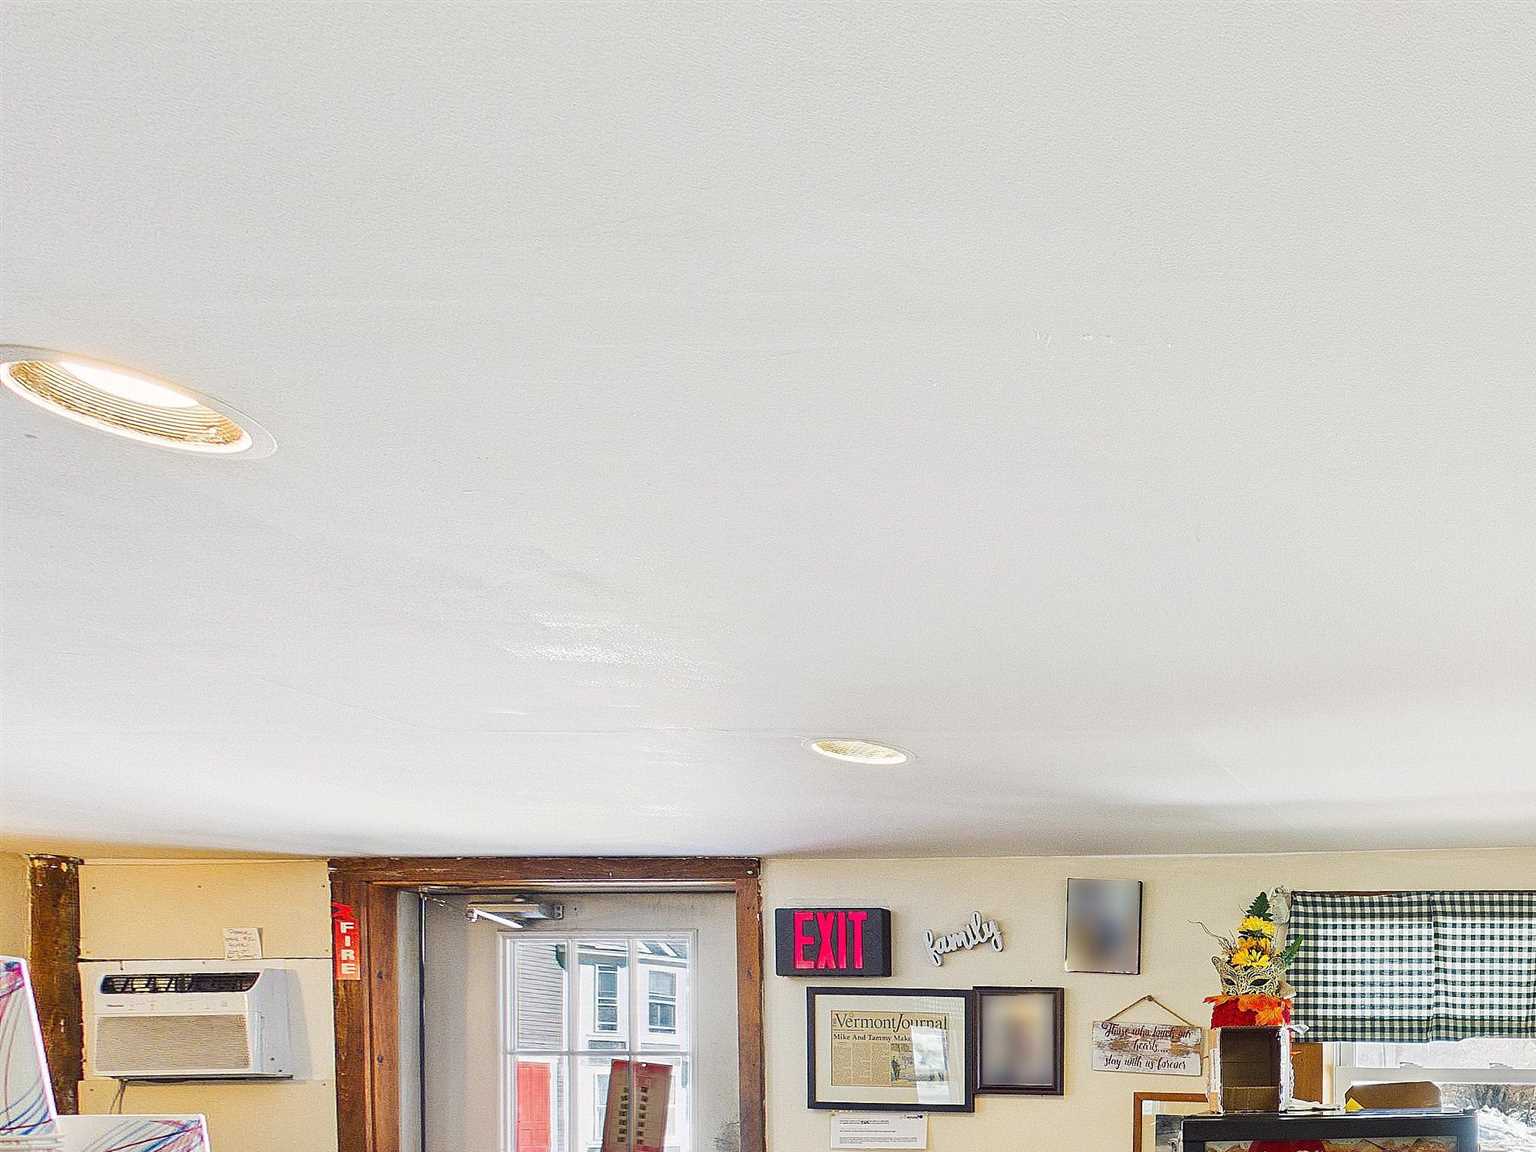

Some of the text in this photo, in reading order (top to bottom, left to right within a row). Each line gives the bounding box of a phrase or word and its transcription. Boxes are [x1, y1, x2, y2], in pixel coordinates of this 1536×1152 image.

[340, 921, 356, 975] FIRE
[793, 911, 868, 969] EXIT
[921, 910, 1004, 968] family
[836, 1013, 947, 1033] Vermont Journal
[1101, 1021, 1130, 1038] Those
[868, 1034, 891, 1042] Tammy
[1104, 1054, 1121, 1070] stay
[1124, 1055, 1142, 1068] with
[1156, 1056, 1186, 1071] forever
